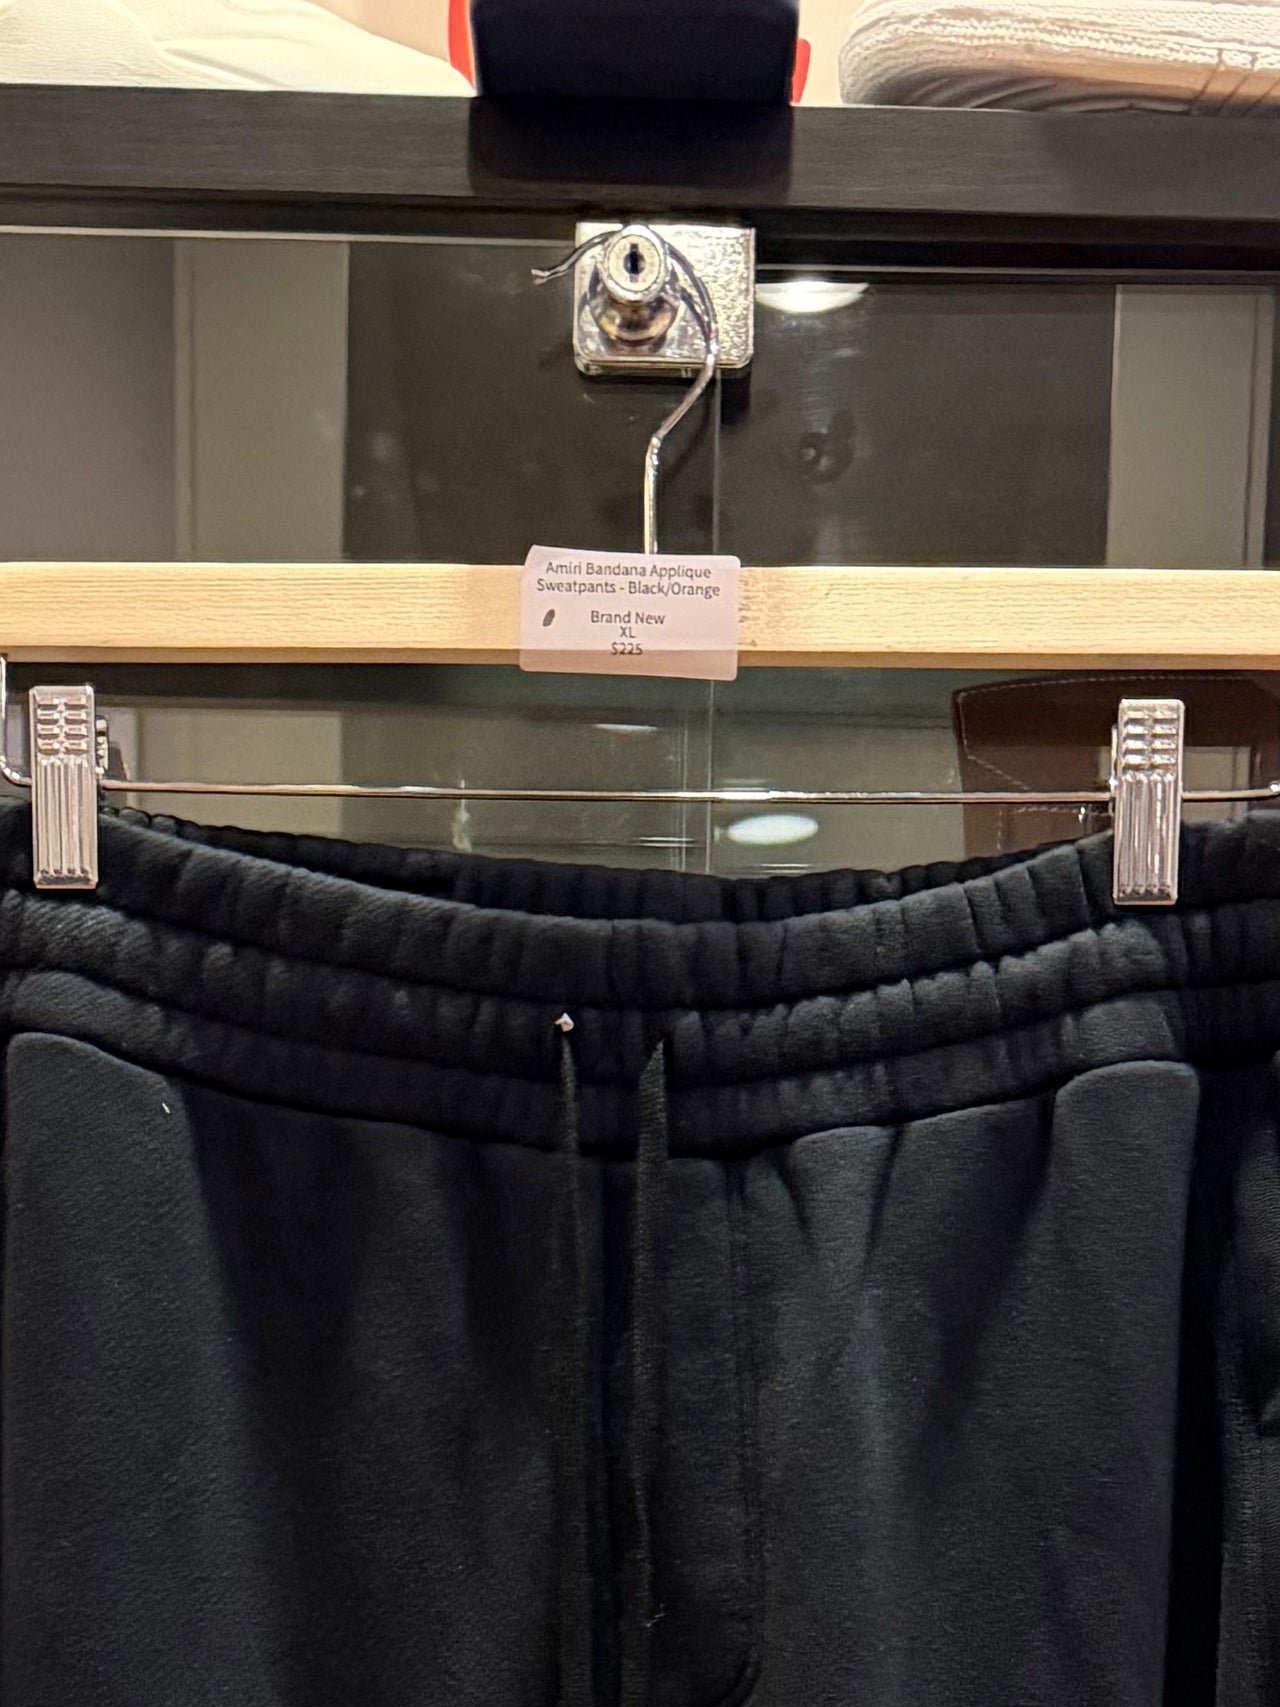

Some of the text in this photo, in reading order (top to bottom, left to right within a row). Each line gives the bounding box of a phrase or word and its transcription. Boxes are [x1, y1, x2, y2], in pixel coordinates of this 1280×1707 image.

[546, 561, 712, 581] Amiri Bandana Applique
[536, 578, 617, 596] Sweatpants
[628, 581, 721, 599] Black/Orange
[590, 610, 666, 625] Brand New
[619, 626, 636, 639] XL
[611, 642, 643, 656] $225
